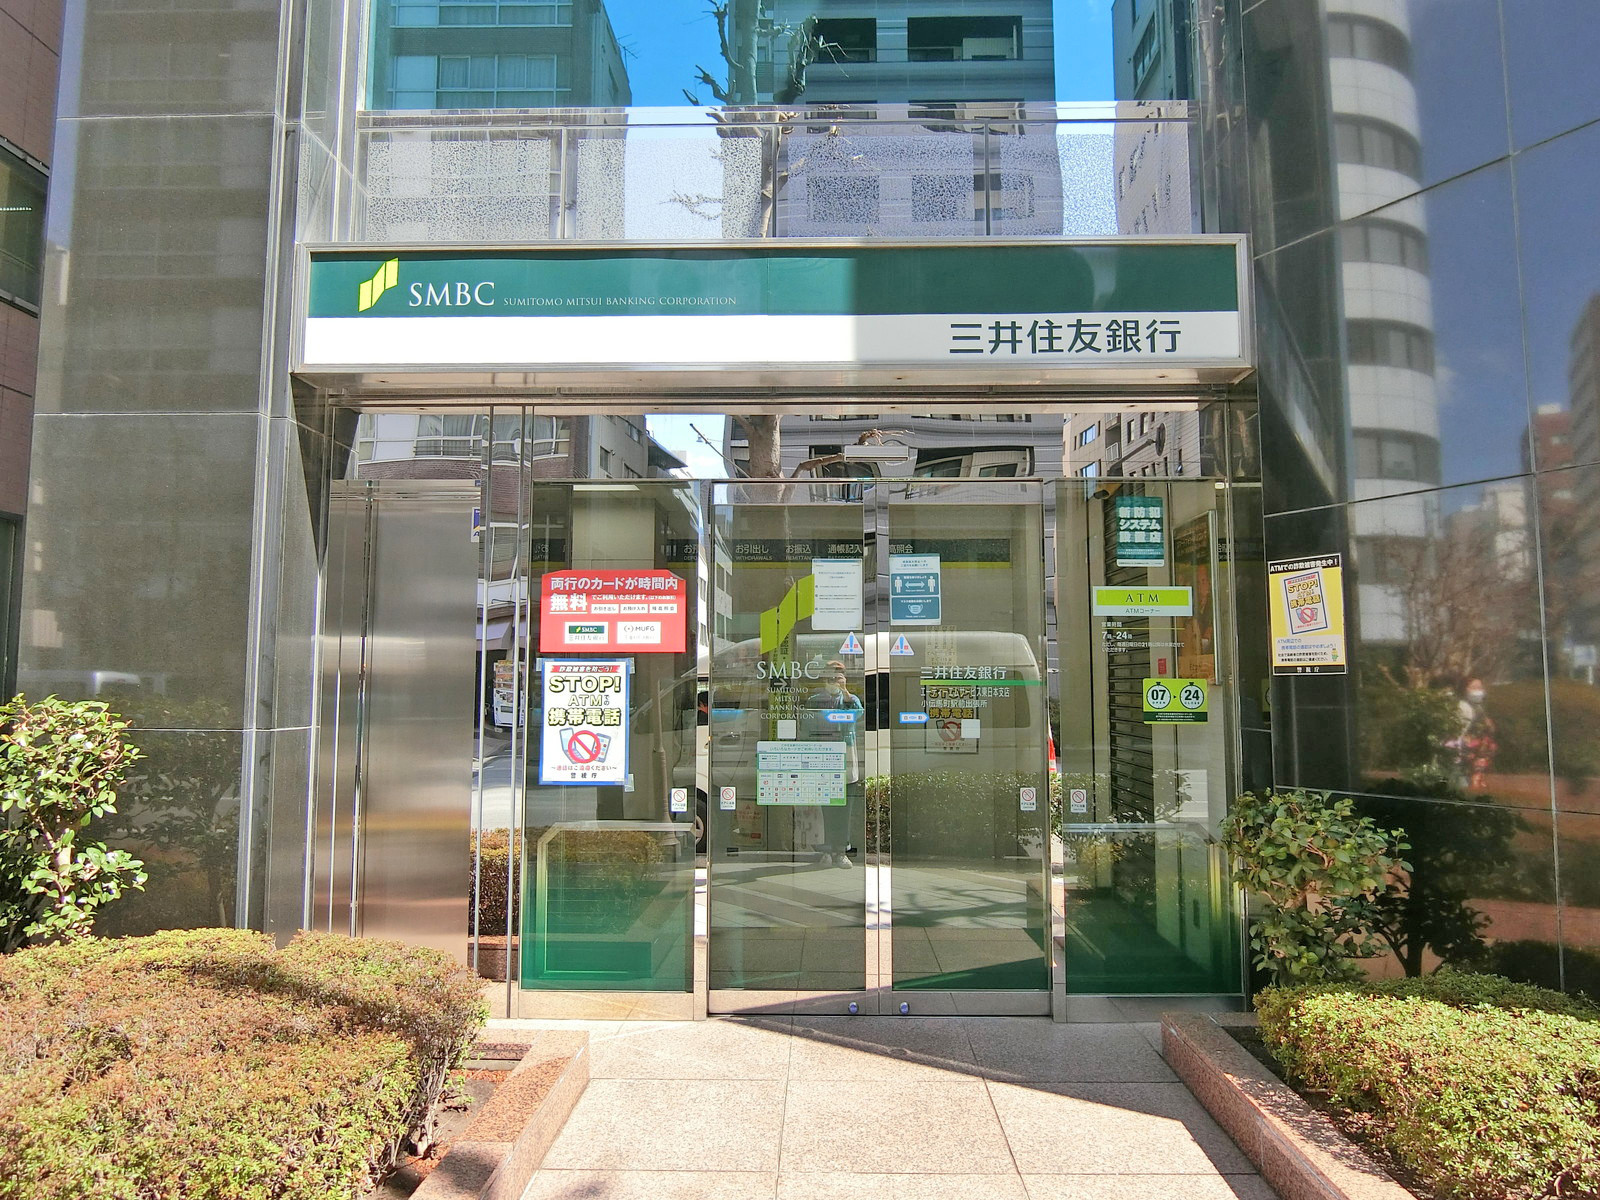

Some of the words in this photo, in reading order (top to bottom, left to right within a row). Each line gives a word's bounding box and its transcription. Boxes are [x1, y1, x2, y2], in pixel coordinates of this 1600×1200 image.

[408, 281, 495, 307] SMBC
[503, 297, 563, 306] SUMITOMO
[566, 297, 603, 306] MITSUI
[605, 296, 656, 306] BANKING
[659, 296, 737, 306] CORPORATION
[949, 318, 1182, 354] 三井住友銀行
[1119, 519, 1161, 530] システム
[735, 544, 769, 554] お引出し
[785, 544, 812, 554] お振込
[827, 544, 863, 554] 通帳記入
[551, 577, 678, 590] 両行のカードが時間内
[1288, 578, 1319, 594] STOP!
[550, 593, 588, 611] 無料
[1125, 593, 1159, 603] ATM
[756, 661, 820, 680] SMBC
[920, 666, 1007, 680] 三井住友銀行
[549, 676, 621, 693] STOP!
[766, 686, 809, 694] SUMITOMO
[1151, 689, 1166, 701] 07
[1184, 689, 1200, 701] 24
[548, 708, 622, 726] 携帯電話
[929, 707, 974, 719] 携帯電話
